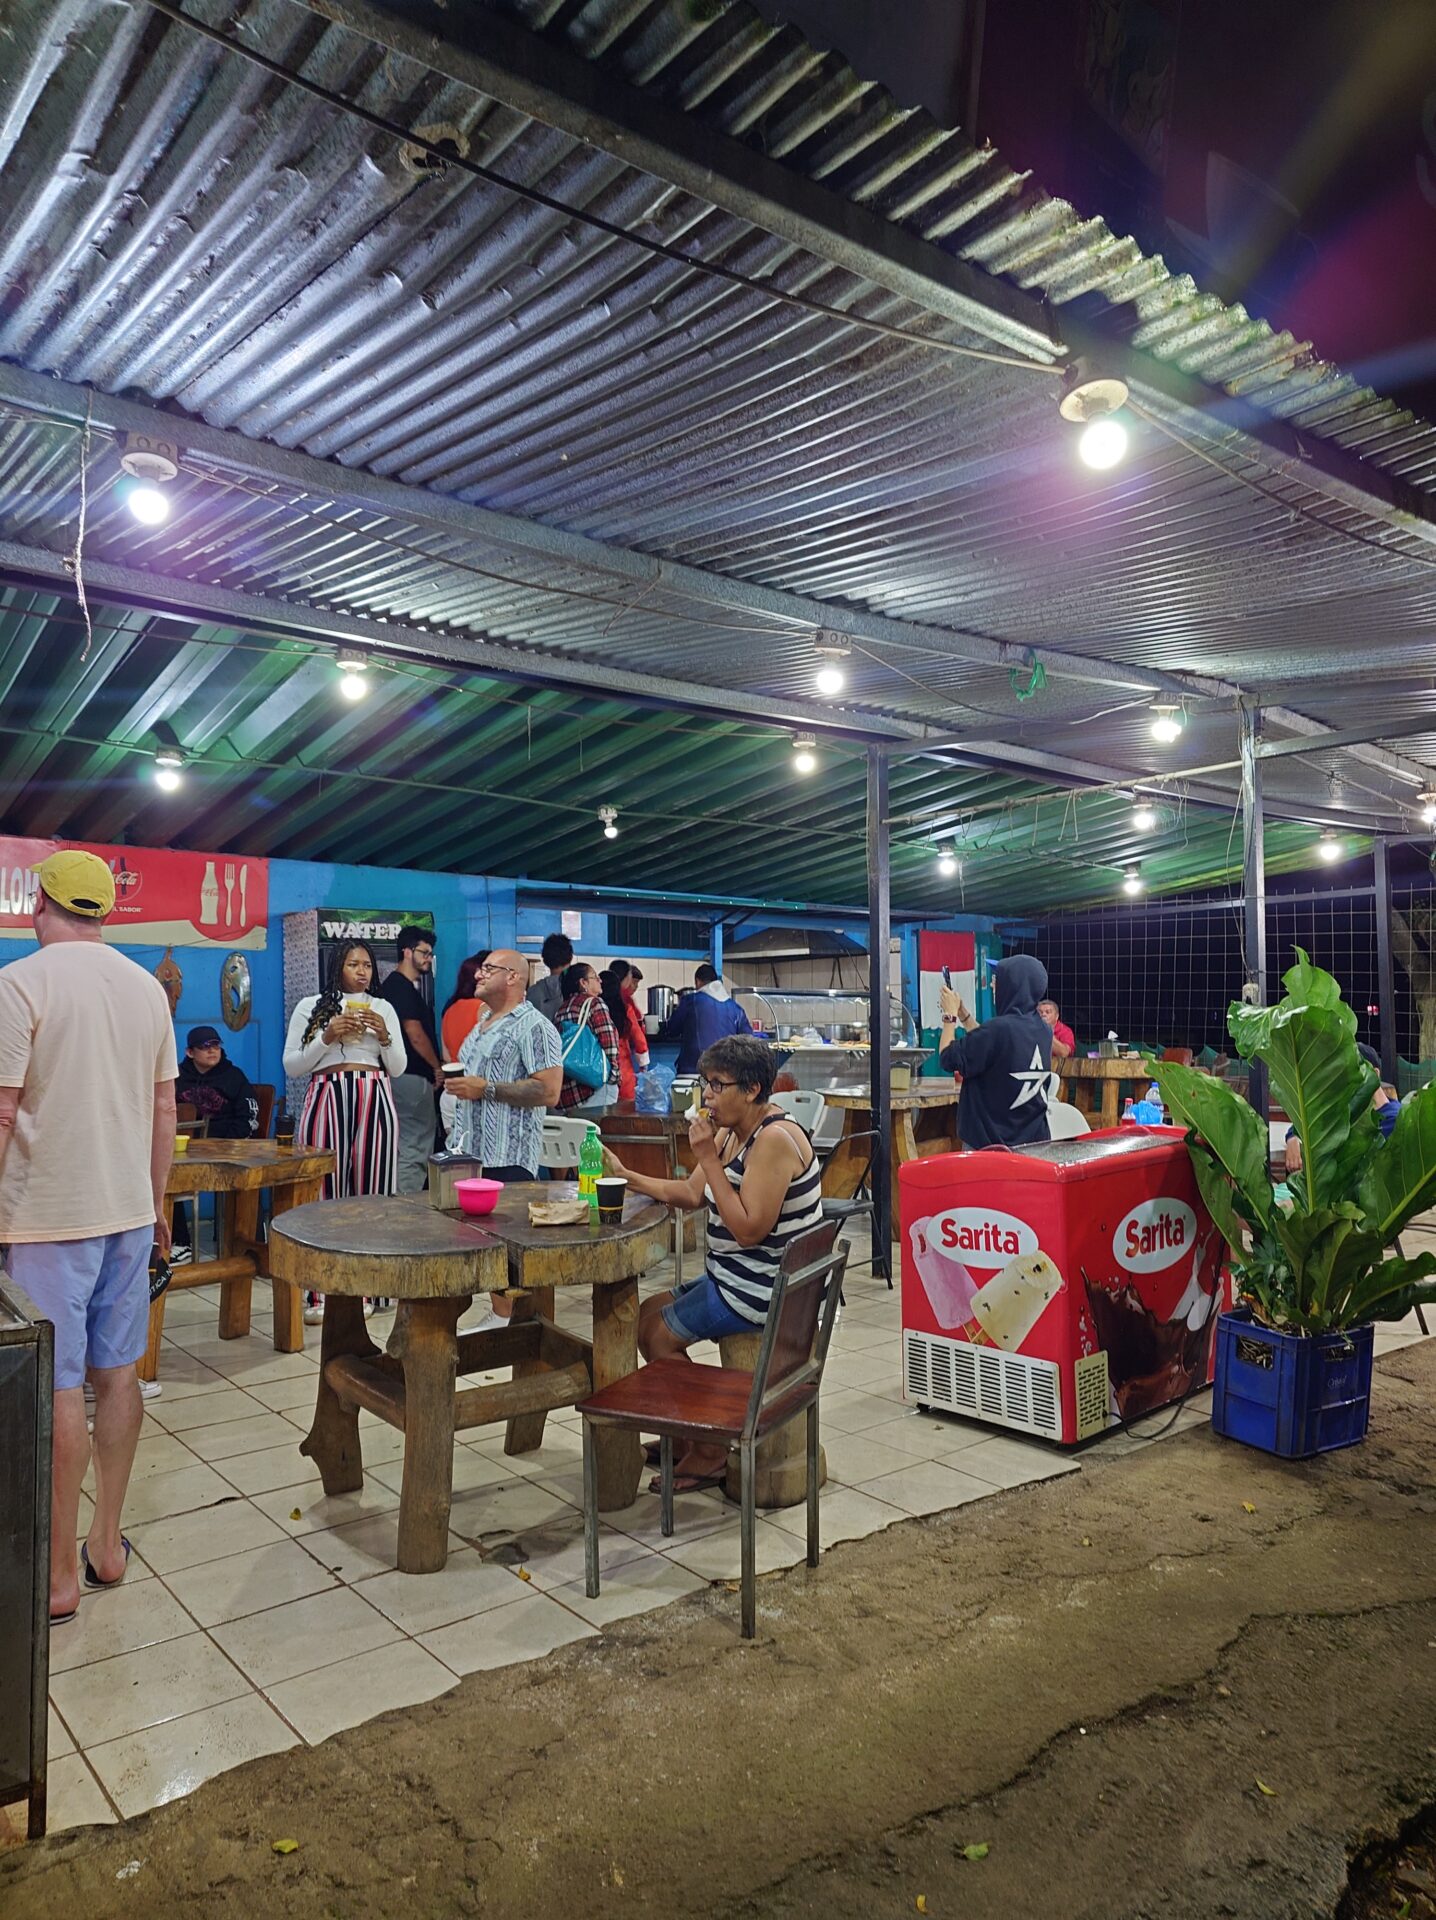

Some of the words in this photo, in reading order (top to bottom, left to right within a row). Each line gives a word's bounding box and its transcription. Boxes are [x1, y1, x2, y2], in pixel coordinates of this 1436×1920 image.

[321, 921, 401, 940] WATER
[941, 1218, 1019, 1254] Sarita
[1125, 1212, 1184, 1258] Sarita
